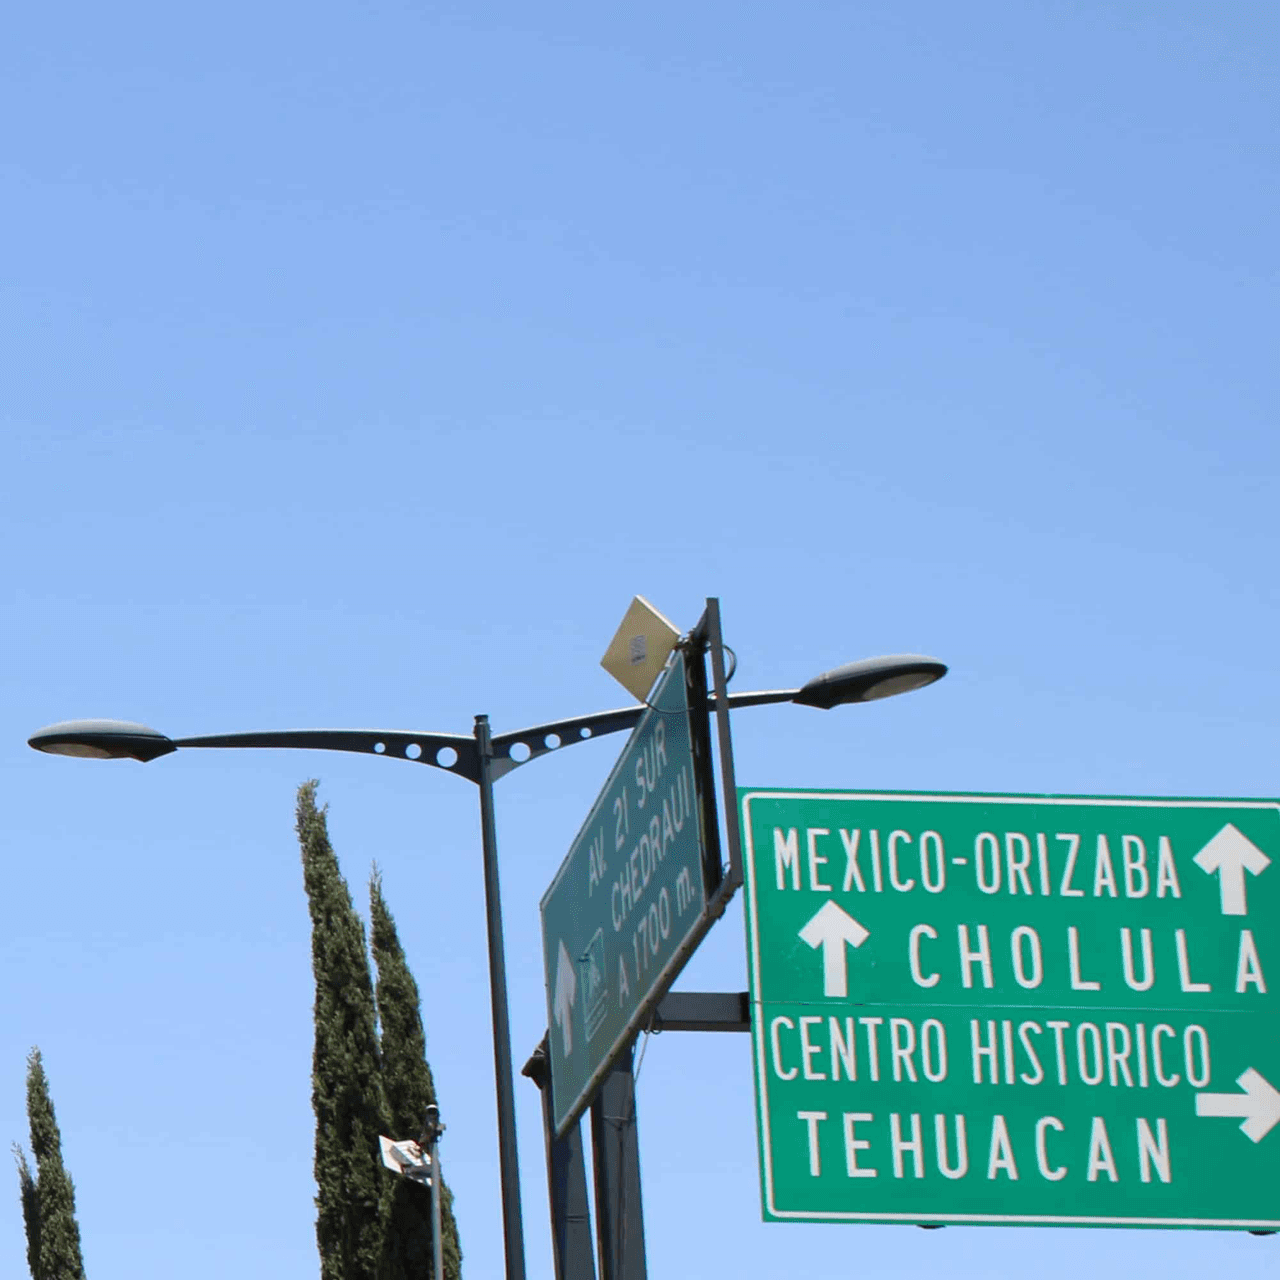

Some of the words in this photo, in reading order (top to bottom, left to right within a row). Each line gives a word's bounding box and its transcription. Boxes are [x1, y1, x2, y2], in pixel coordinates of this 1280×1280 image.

[588, 826, 608, 899] AV.
[613, 786, 629, 853] 21
[635, 718, 667, 809] SUR
[611, 766, 691, 932] CHEDRAUI
[772, 826, 1182, 899] MEXICO-ORIZABA
[618, 953, 629, 1008] A
[632, 885, 671, 982] 1700
[908, 923, 1267, 994] CHOLULA
[770, 1015, 948, 1083] CENTRO
[971, 1019, 1212, 1088] HISTORICO
[797, 1110, 1173, 1184] TEHUACAN
